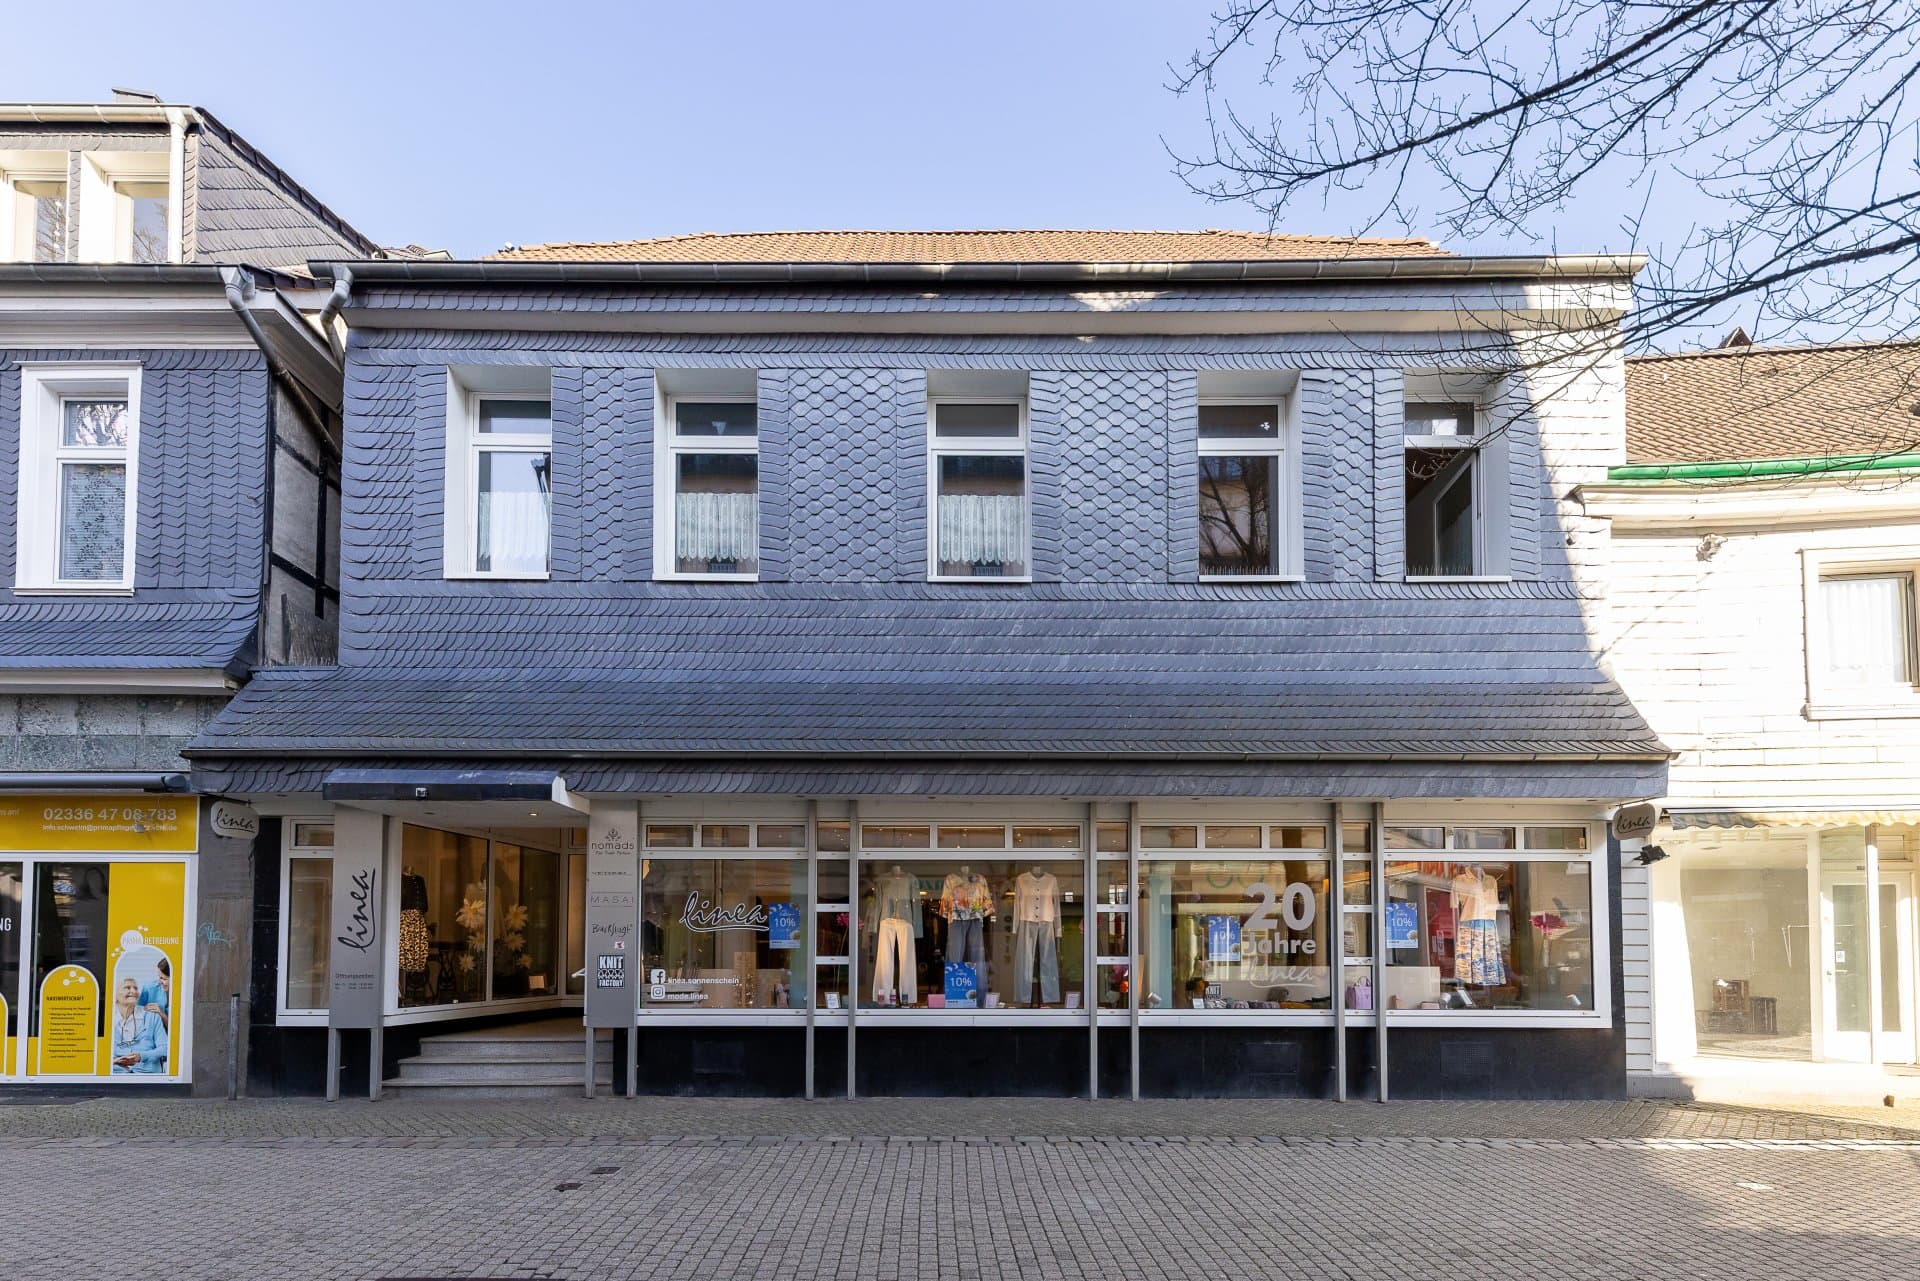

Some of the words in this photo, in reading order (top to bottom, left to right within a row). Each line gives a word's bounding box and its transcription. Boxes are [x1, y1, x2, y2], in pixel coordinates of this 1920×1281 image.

[44, 808, 94, 821] 02336
[98, 808, 119, 821] 47
[216, 807, 256, 834] linea
[1616, 814, 1651, 834] linea
[591, 842, 634, 850] nomads
[591, 895, 633, 904] MASAI
[338, 867, 375, 954] linea
[679, 890, 770, 932] linea
[1244, 882, 1316, 931] 20
[775, 917, 796, 927] 10%
[1391, 917, 1413, 927] 10%
[1243, 932, 1317, 954] Jahre
[600, 956, 623, 969] KNIT
[600, 979, 624, 987] FACTORY
[950, 977, 972, 987] 10%
